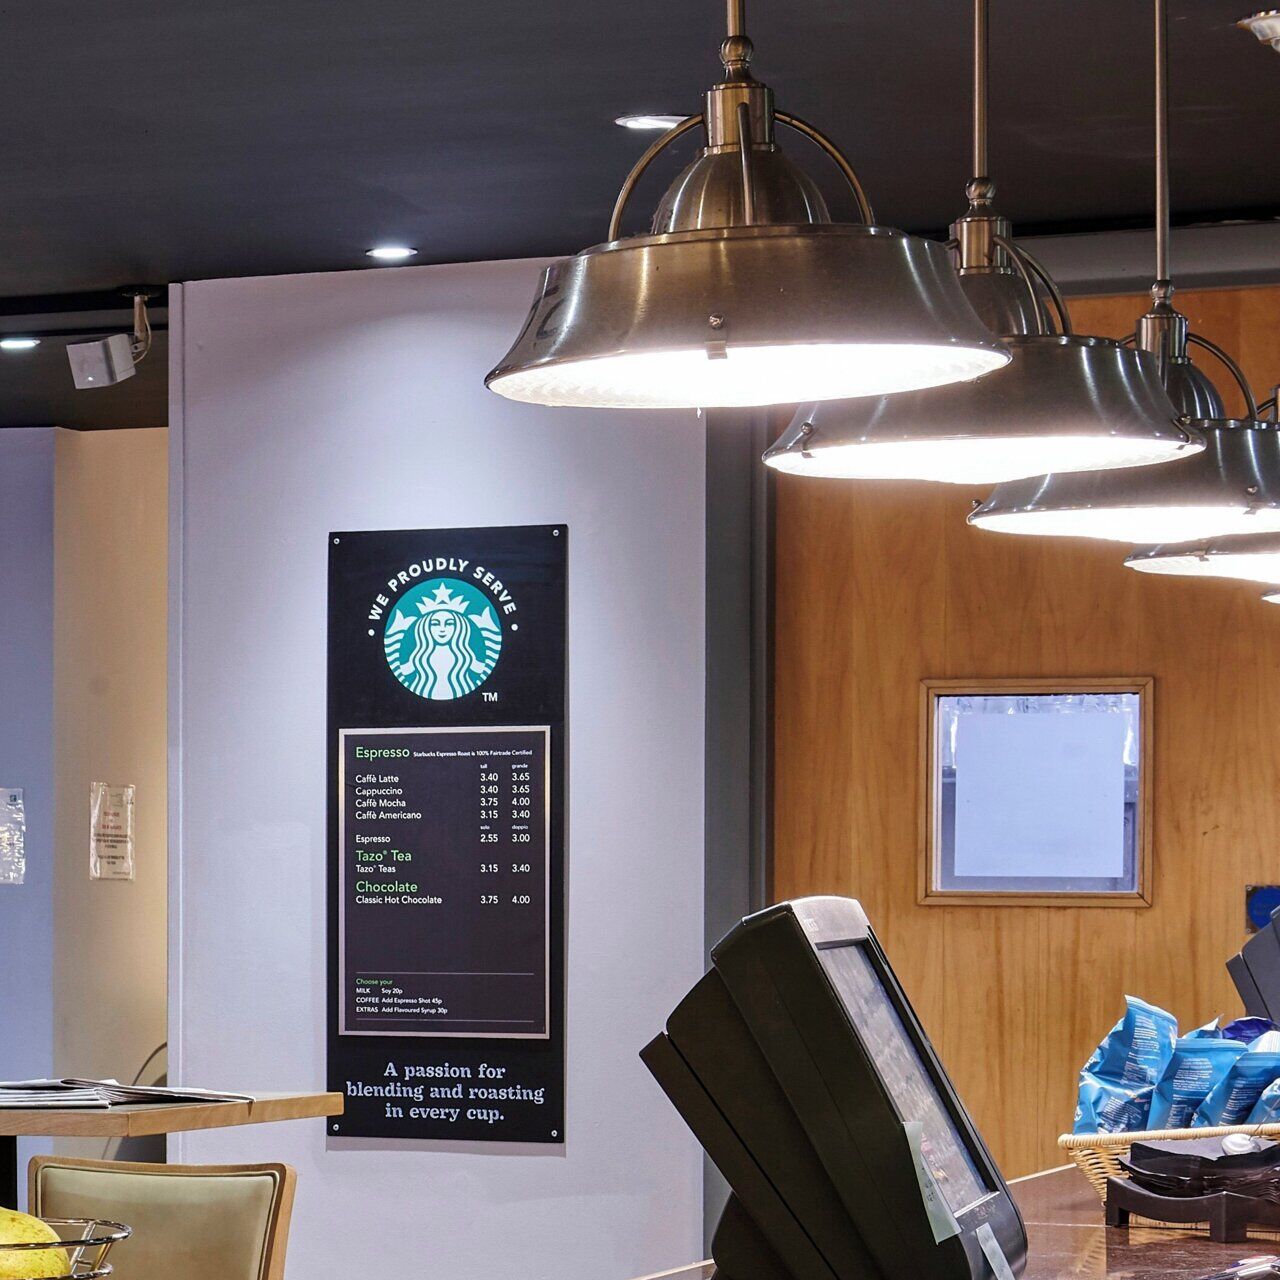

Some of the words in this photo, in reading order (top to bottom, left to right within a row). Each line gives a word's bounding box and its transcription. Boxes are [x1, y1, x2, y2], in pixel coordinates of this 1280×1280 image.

[369, 594, 391, 622] WE
[388, 558, 470, 593] PROUDLY
[472, 567, 516, 615] SERVE
[356, 747, 409, 762] Espresso
[356, 774, 376, 784] Caffè
[379, 774, 399, 783] Latte
[481, 773, 498, 782] 3.40
[512, 773, 529, 782] 3.65
[356, 787, 402, 797] Cappuccino
[481, 785, 498, 794] 3.40
[512, 785, 529, 794] 3.65
[356, 799, 377, 808] Caffè
[379, 799, 406, 808] Mocha
[481, 798, 498, 807] 3.75
[512, 797, 530, 806] 4.00
[356, 811, 377, 820] Caffè
[379, 811, 421, 820] Americano
[481, 810, 498, 819] 3.15
[512, 810, 530, 819] 3.40
[356, 835, 390, 845] Espresso
[481, 834, 498, 843] 2.55
[512, 834, 530, 843] 3.00
[391, 850, 411, 862] Tea
[378, 864, 396, 873] Teas
[481, 864, 498, 873] 3.15
[512, 864, 530, 873] 3.40
[356, 881, 417, 893] Chocolate
[356, 895, 382, 904] Classic
[385, 896, 399, 905] Hot
[402, 895, 442, 904] Chocolate
[481, 895, 498, 904] 3.75
[512, 895, 530, 904] 4.00
[356, 977, 378, 985] Choose
[380, 979, 392, 987] your
[382, 987, 391, 995] Soy
[393, 987, 403, 995] 20p
[356, 996, 379, 1004] COFFEE
[394, 997, 417, 1005] Espresso
[421, 1006, 436, 1015] Syrup
[384, 1063, 398, 1077] A
[404, 1063, 471, 1080] passion
[479, 1064, 505, 1079] for
[346, 1081, 424, 1101] blending
[430, 1084, 463, 1099] and
[469, 1085, 544, 1104] roasting
[386, 1103, 403, 1118] in
[410, 1108, 460, 1122] every
[467, 1109, 504, 1124] cup.
